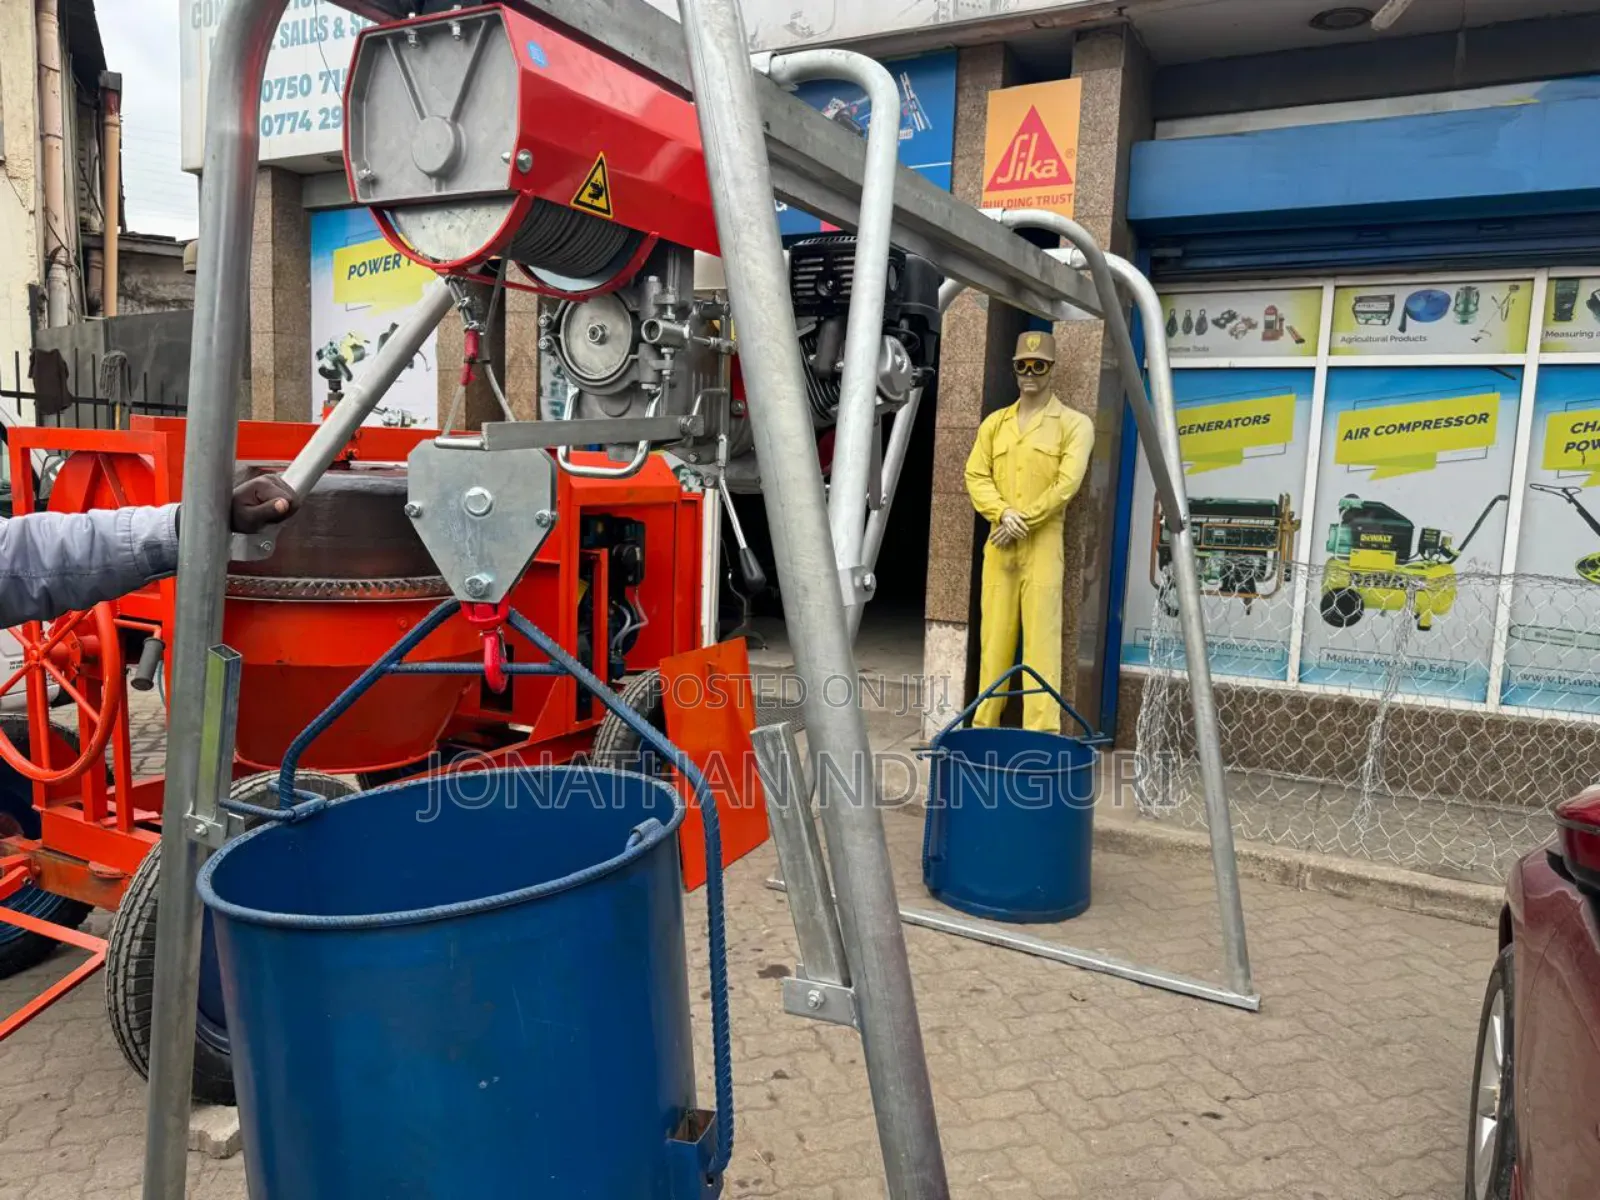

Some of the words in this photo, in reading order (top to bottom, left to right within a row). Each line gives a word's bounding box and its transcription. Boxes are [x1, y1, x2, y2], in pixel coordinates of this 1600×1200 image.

[280, 15, 328, 48] SALES
[333, 16, 345, 39] &
[261, 73, 313, 103] 0750
[261, 110, 312, 137] 0774
[319, 106, 343, 130] 29
[996, 132, 1060, 185] Sika
[1036, 193, 1073, 207] TRUST
[347, 253, 402, 280] POWER
[1340, 335, 1388, 345] Agricultural
[1389, 334, 1427, 343] Products
[1545, 330, 1594, 340] Measuring
[1178, 413, 1271, 436] GENERATORS
[1343, 427, 1369, 442] AIR
[1373, 412, 1490, 437] COMPRESSOR
[1326, 653, 1370, 668] Making
[1429, 663, 1460, 678] Easy
